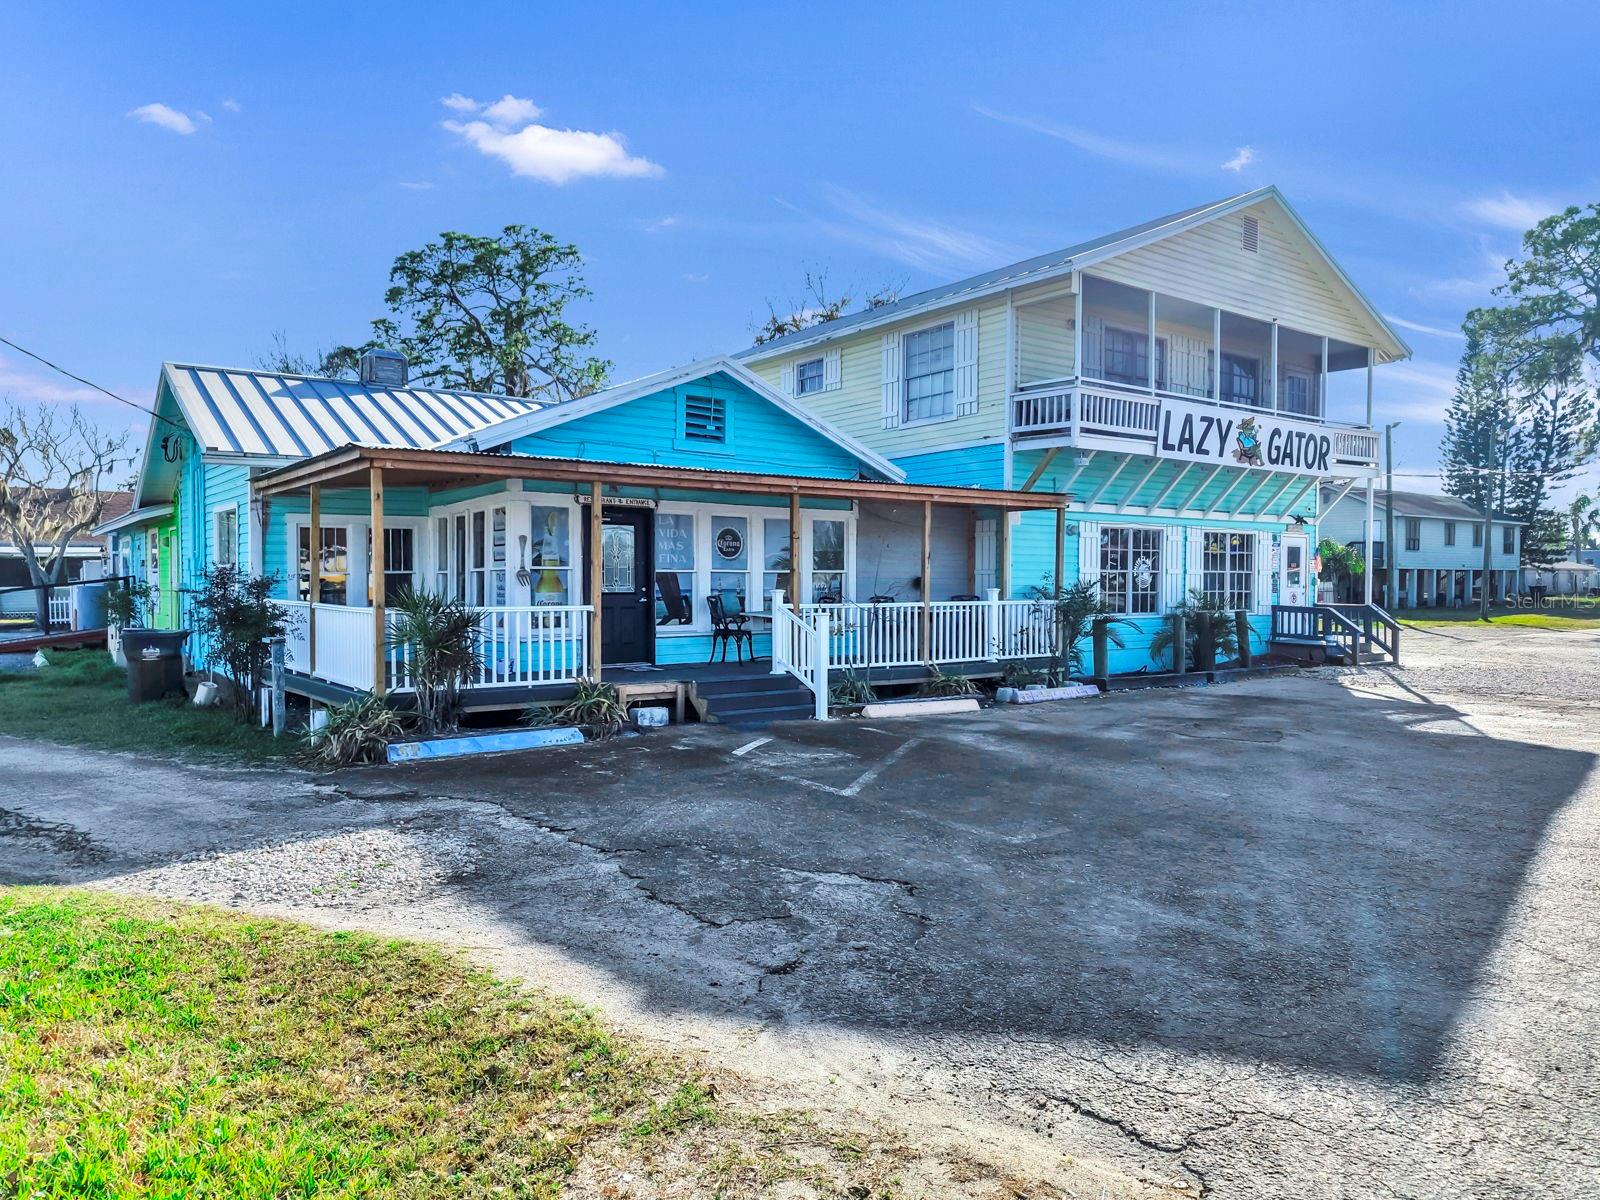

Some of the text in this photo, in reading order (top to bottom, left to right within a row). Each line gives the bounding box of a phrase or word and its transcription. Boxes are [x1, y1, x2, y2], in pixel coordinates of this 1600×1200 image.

[1162, 410, 1331, 471] LAZY GATOR
[625, 498, 650, 506] ENTRANCE
[658, 515, 674, 525] LA
[659, 528, 688, 539] VIDA
[717, 539, 740, 549] Corona
[658, 553, 688, 563] FINA
